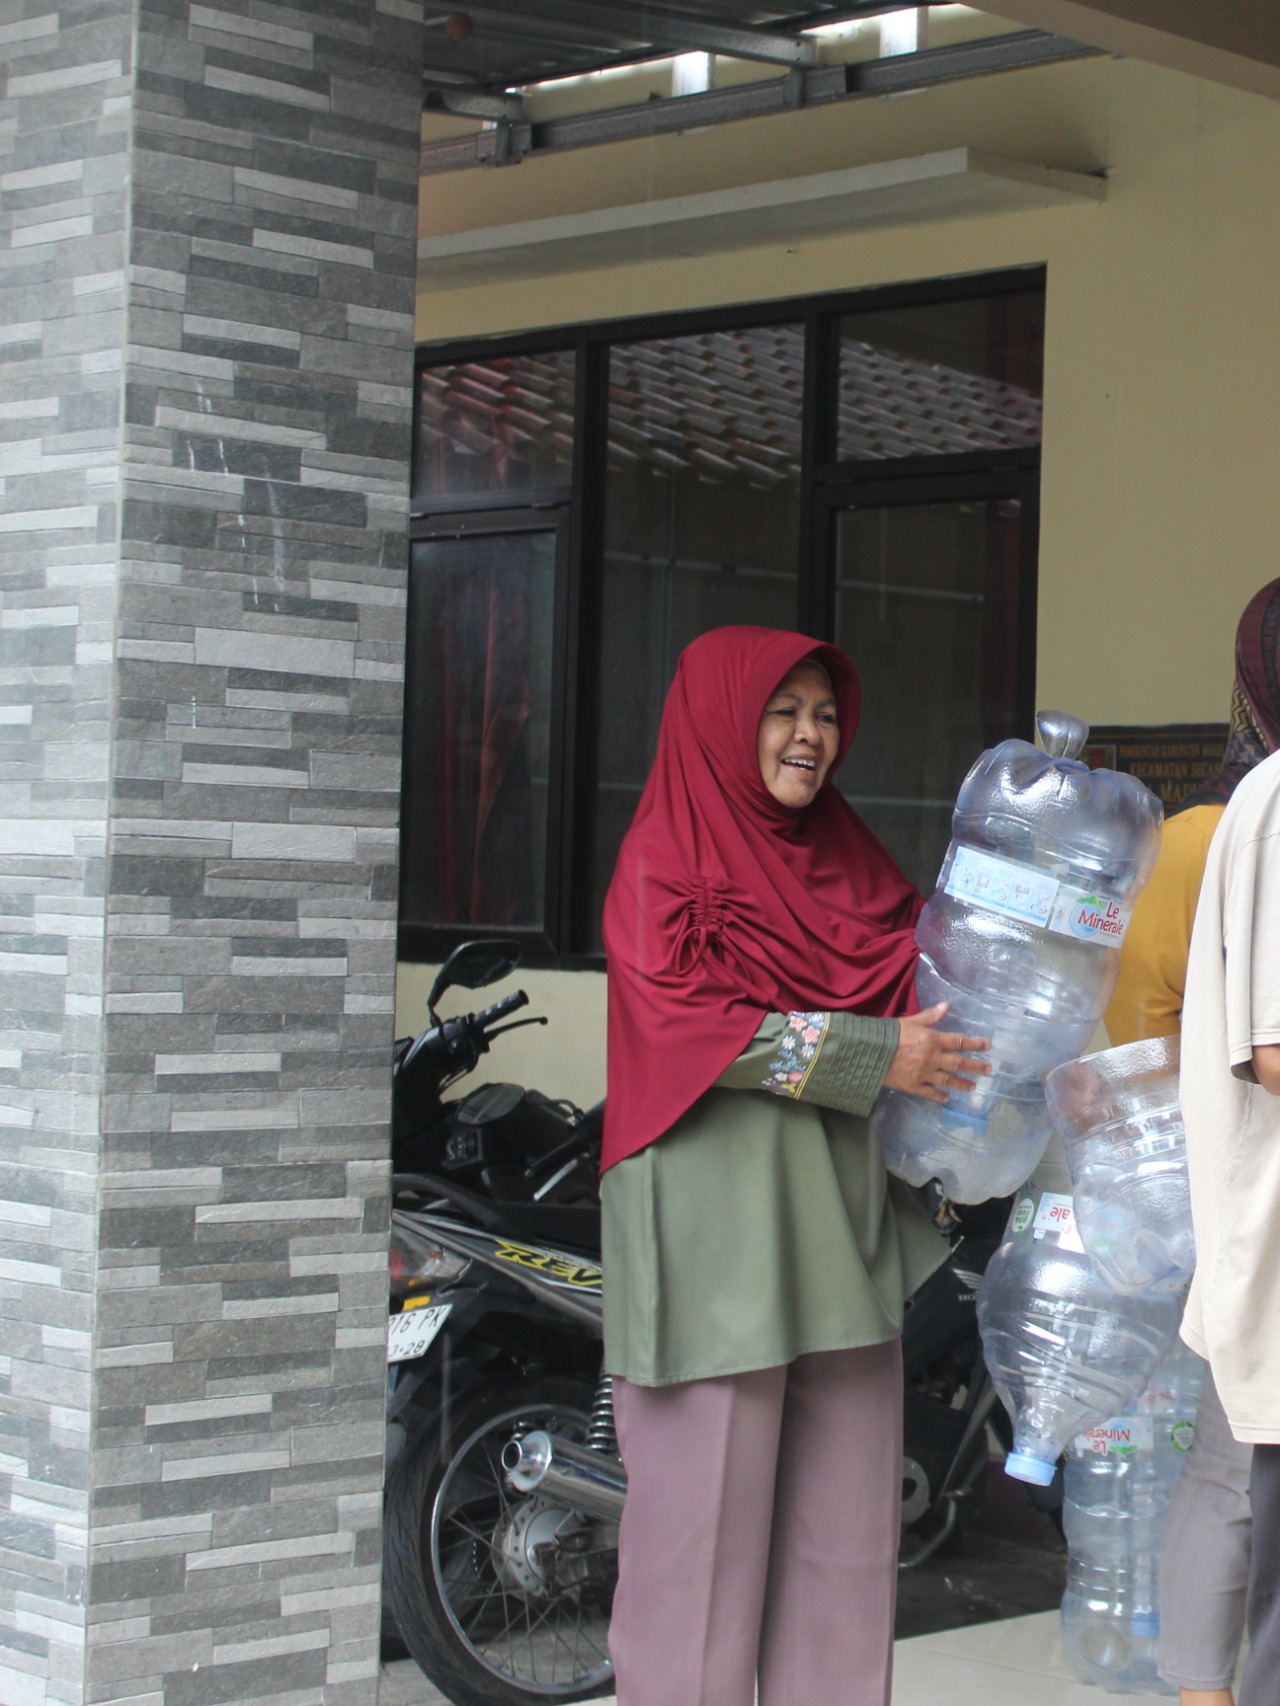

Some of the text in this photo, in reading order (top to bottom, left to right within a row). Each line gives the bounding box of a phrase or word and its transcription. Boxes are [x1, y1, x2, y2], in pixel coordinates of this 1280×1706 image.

[1106, 901, 1120, 919] Le
[1077, 909, 1124, 935] Minerale
[418, 1306, 447, 1330] PK
[1093, 1440, 1107, 1456] Le
